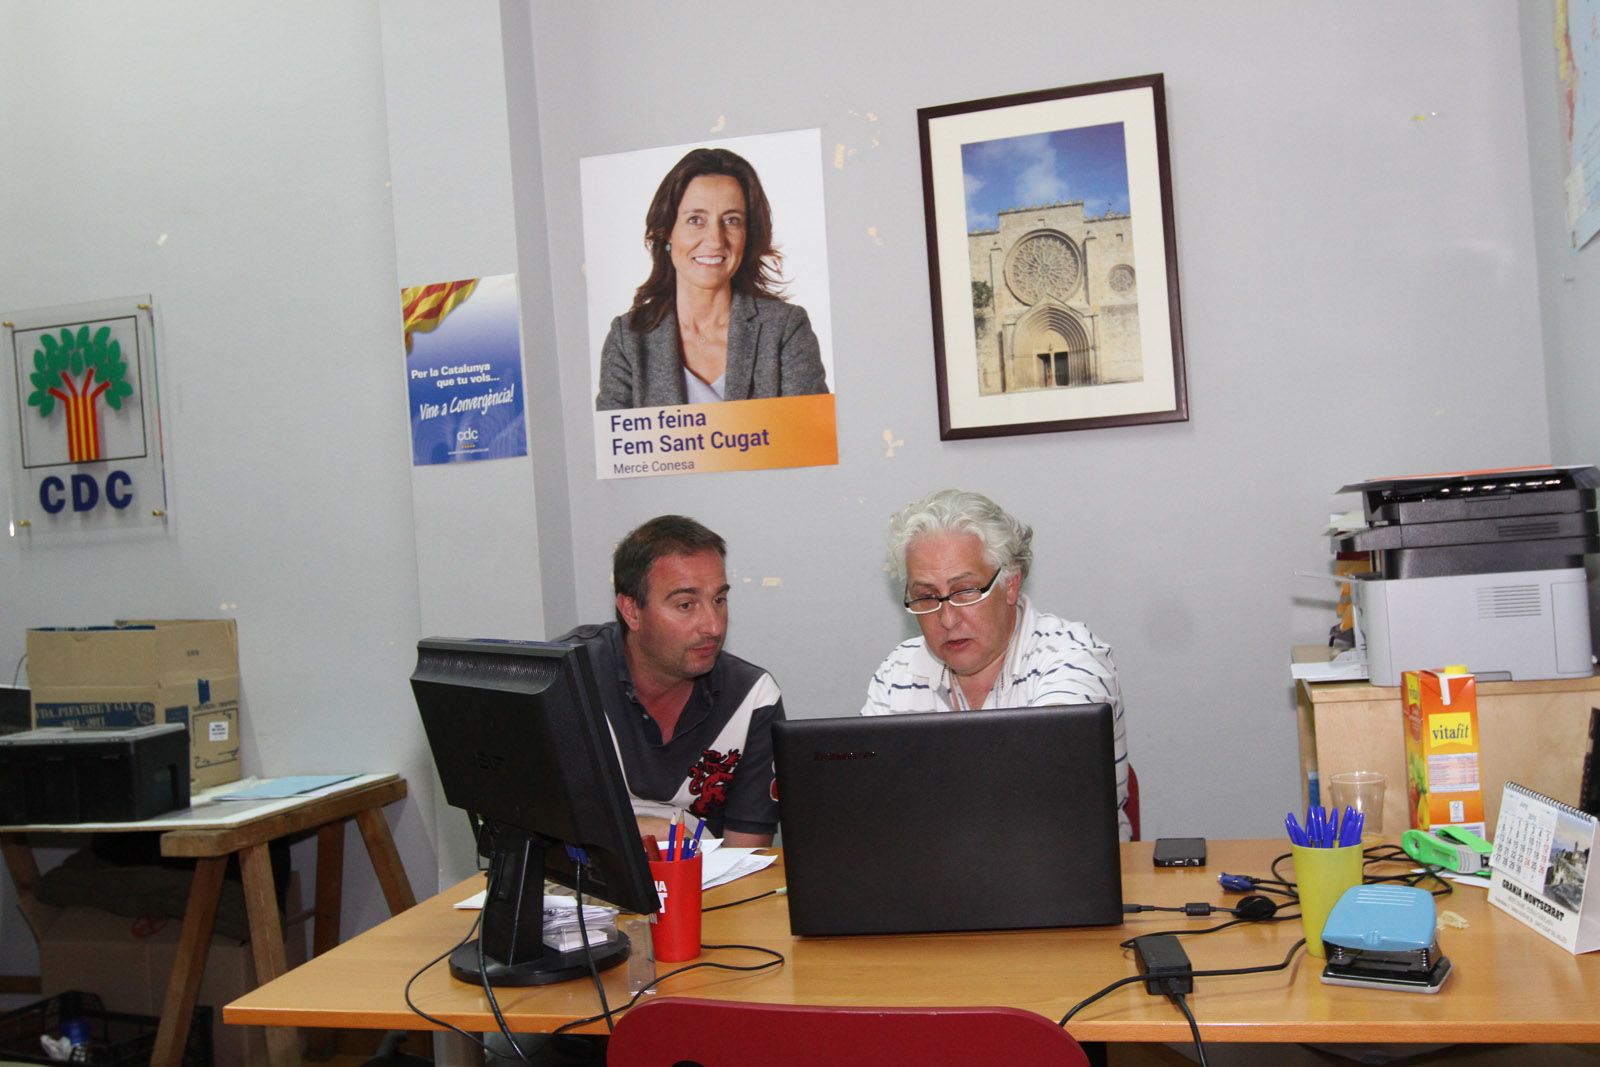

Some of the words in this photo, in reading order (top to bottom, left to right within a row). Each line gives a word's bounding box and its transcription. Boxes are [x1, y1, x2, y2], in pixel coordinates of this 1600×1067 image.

[411, 369, 428, 379] Per
[429, 368, 439, 377] la
[441, 363, 491, 376] Catalunya
[436, 379, 455, 389] que
[457, 376, 468, 385] tu
[420, 403, 439, 420] Vine
[441, 403, 448, 416] a
[611, 414, 652, 432] Fem
[658, 409, 706, 429] feina
[456, 427, 479, 441] cdc
[612, 437, 653, 456] Fem
[660, 433, 705, 453] Sant
[711, 429, 769, 452] Cugat
[613, 461, 649, 475] Mercè
[652, 460, 695, 472] Conesa
[39, 470, 133, 515] CDC
[1432, 722, 1470, 740] vitafit
[1523, 891, 1565, 921] MONTSERRAT
